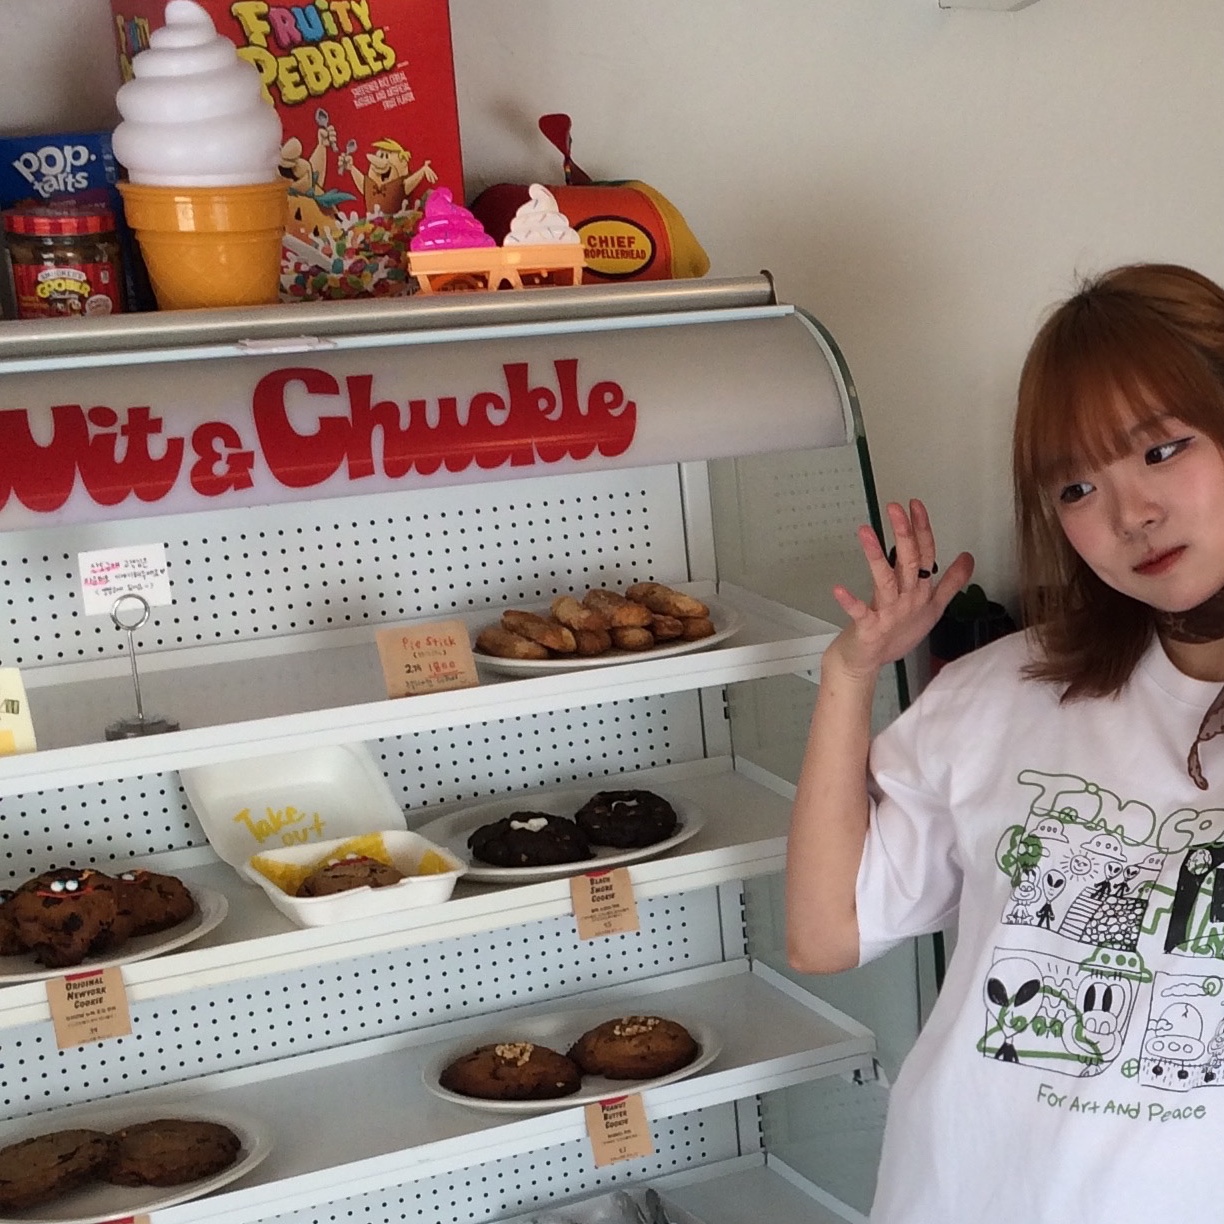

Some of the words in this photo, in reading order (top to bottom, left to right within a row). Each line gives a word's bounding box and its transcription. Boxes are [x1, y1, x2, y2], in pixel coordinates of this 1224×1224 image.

[238, 29, 396, 104] PEBBLES
[33, 171, 88, 198] tarts
[584, 248, 647, 261] ROPELLERHEAD
[587, 235, 636, 248] CHIEF
[252, 358, 637, 488] Chuckle
[402, 636, 420, 650] Pie
[426, 636, 456, 647] Stick
[232, 806, 306, 845] Take
[282, 811, 326, 847] out
[1037, 1083, 1067, 1107] For
[1069, 1096, 1100, 1114] Art
[1148, 1102, 1206, 1122] Peace
